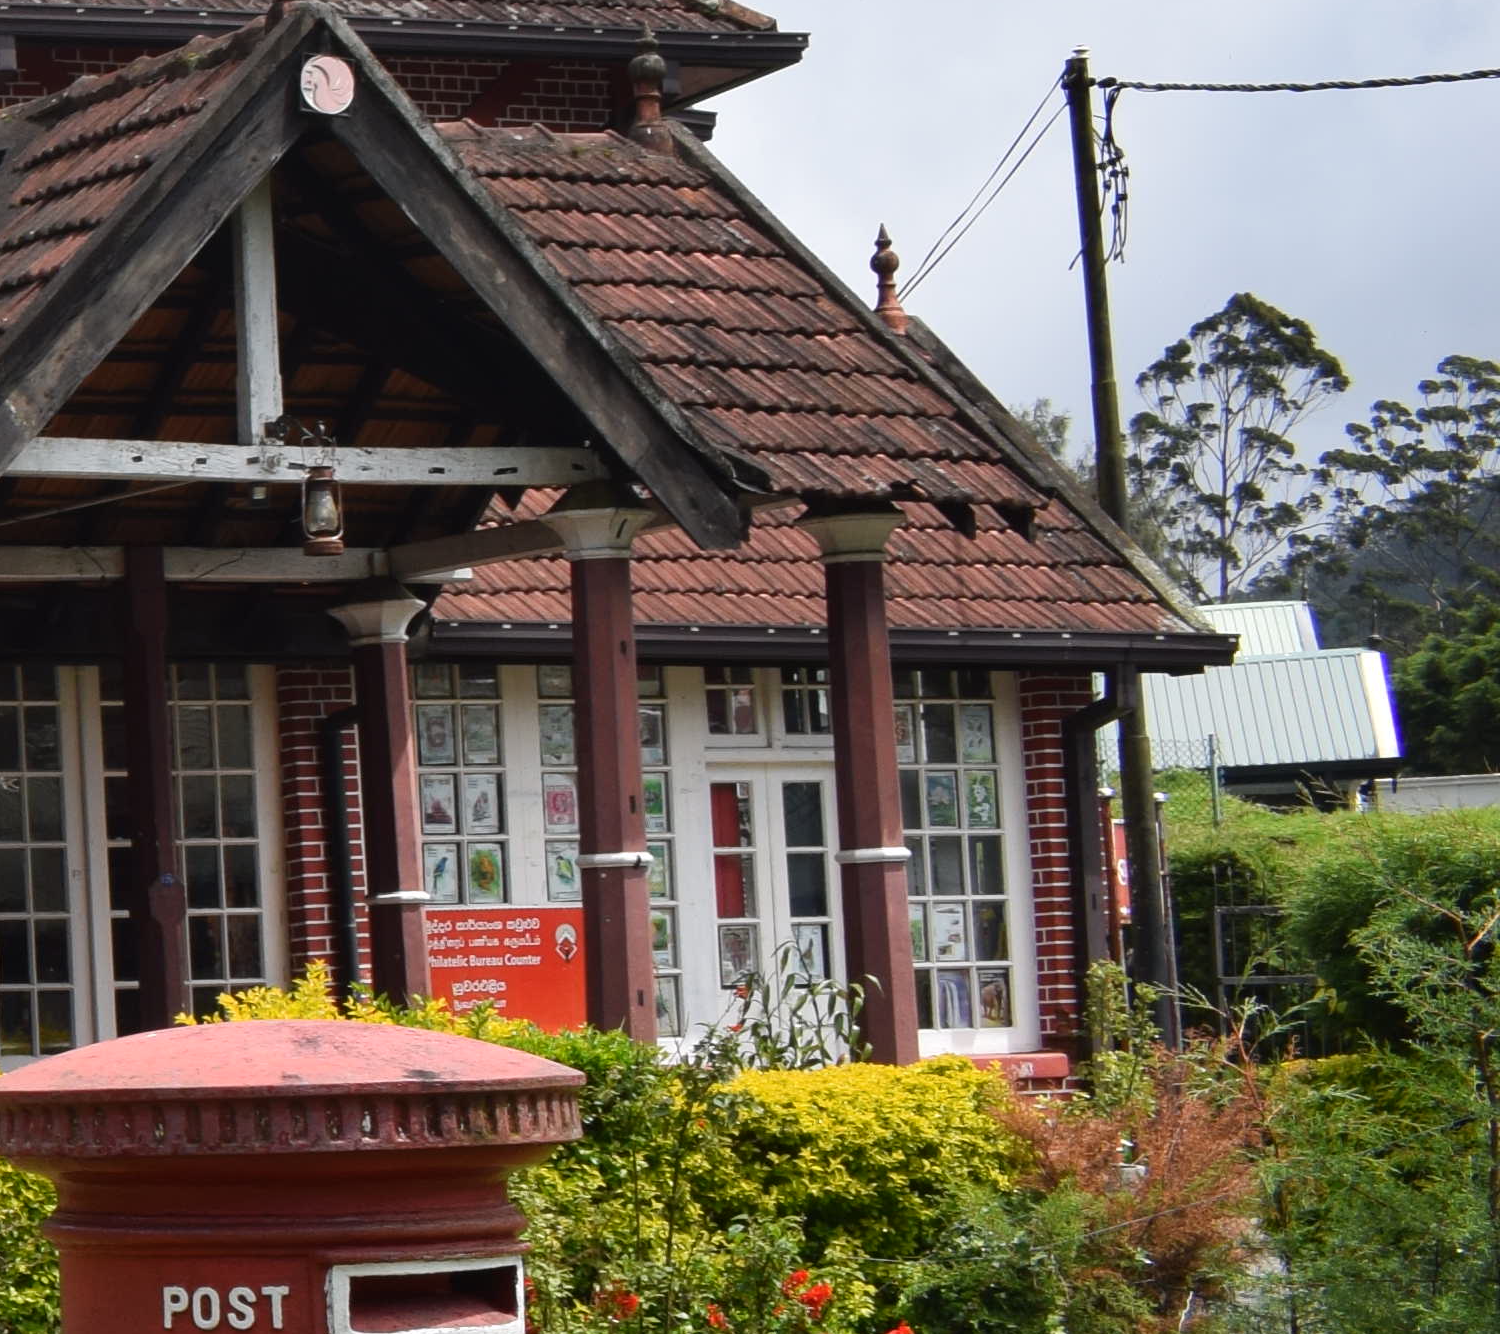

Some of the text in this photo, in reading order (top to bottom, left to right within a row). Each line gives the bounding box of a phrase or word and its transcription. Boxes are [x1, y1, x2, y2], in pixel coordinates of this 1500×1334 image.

[469, 954, 504, 967] Bureau
[504, 953, 541, 966] Counter
[162, 1285, 291, 1330] POST
